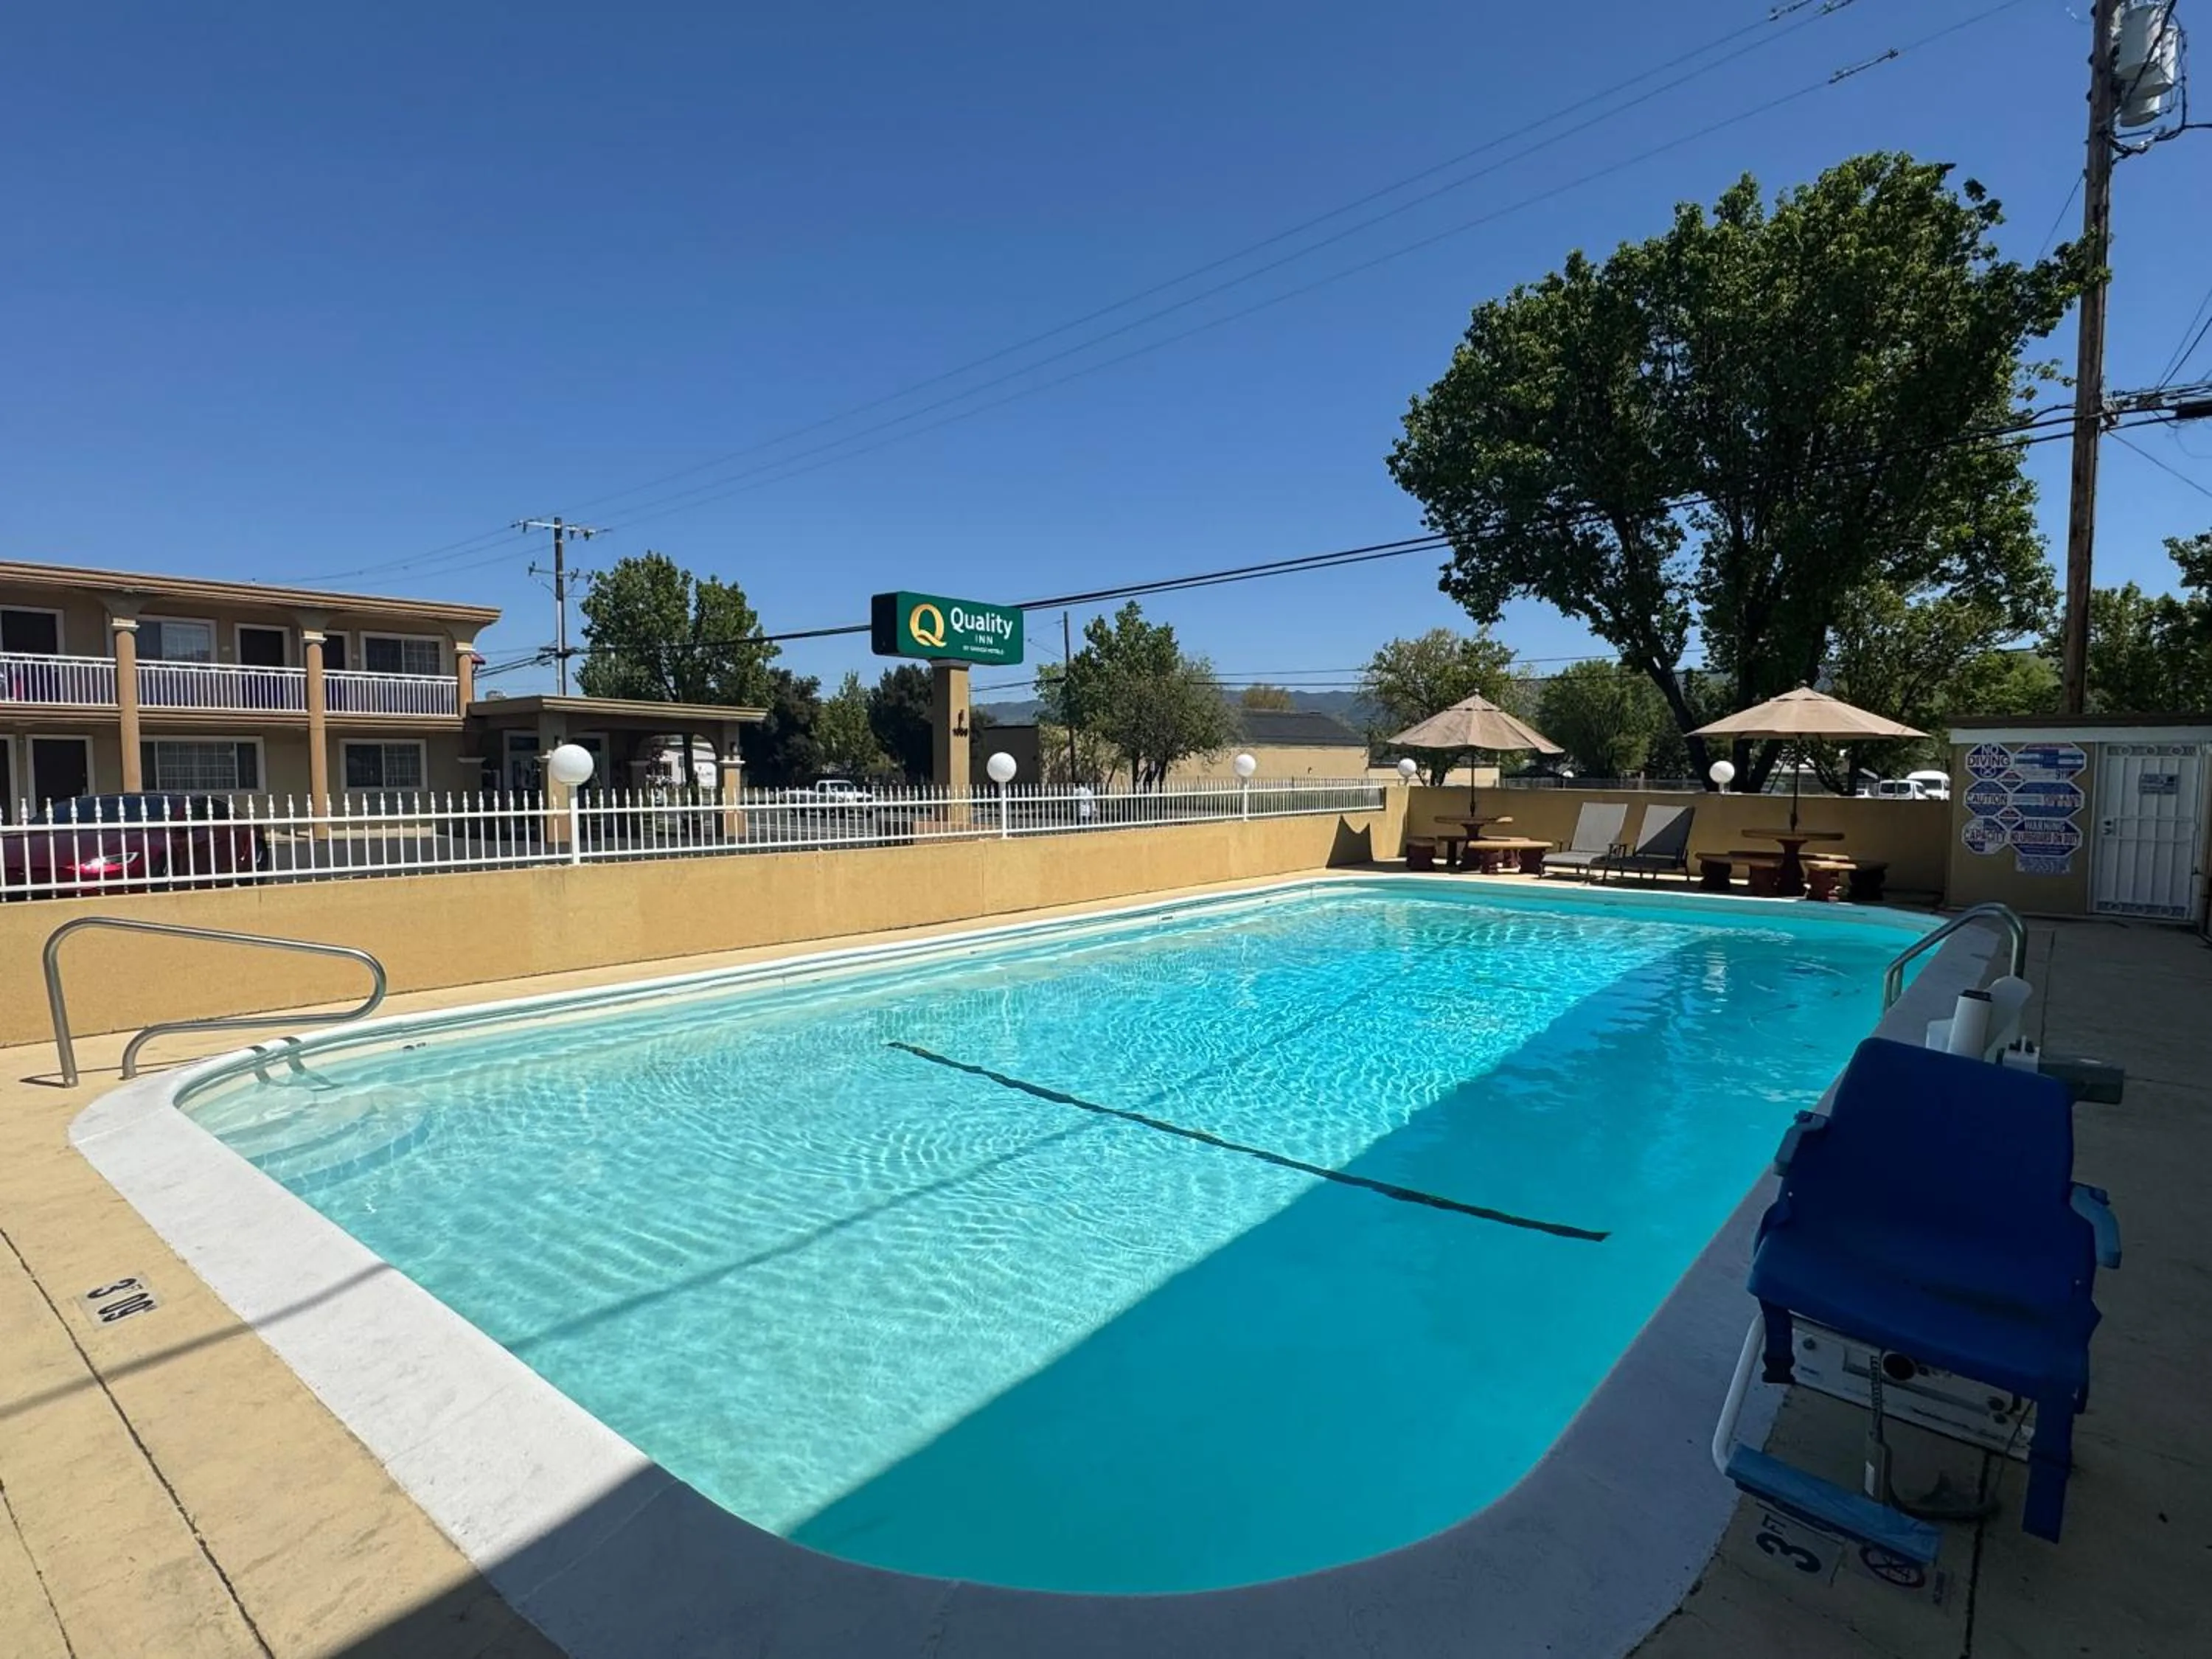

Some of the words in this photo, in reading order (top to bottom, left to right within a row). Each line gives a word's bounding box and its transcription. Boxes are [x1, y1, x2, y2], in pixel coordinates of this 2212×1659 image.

[909, 604, 947, 647] Q
[950, 607, 1013, 639] Quality
[975, 635, 993, 645] INN
[1967, 756, 2011, 766] DIVING
[1966, 794, 2008, 804] CAUTION
[87, 1278, 136, 1298] 3
[1756, 1531, 1822, 1573] 3
